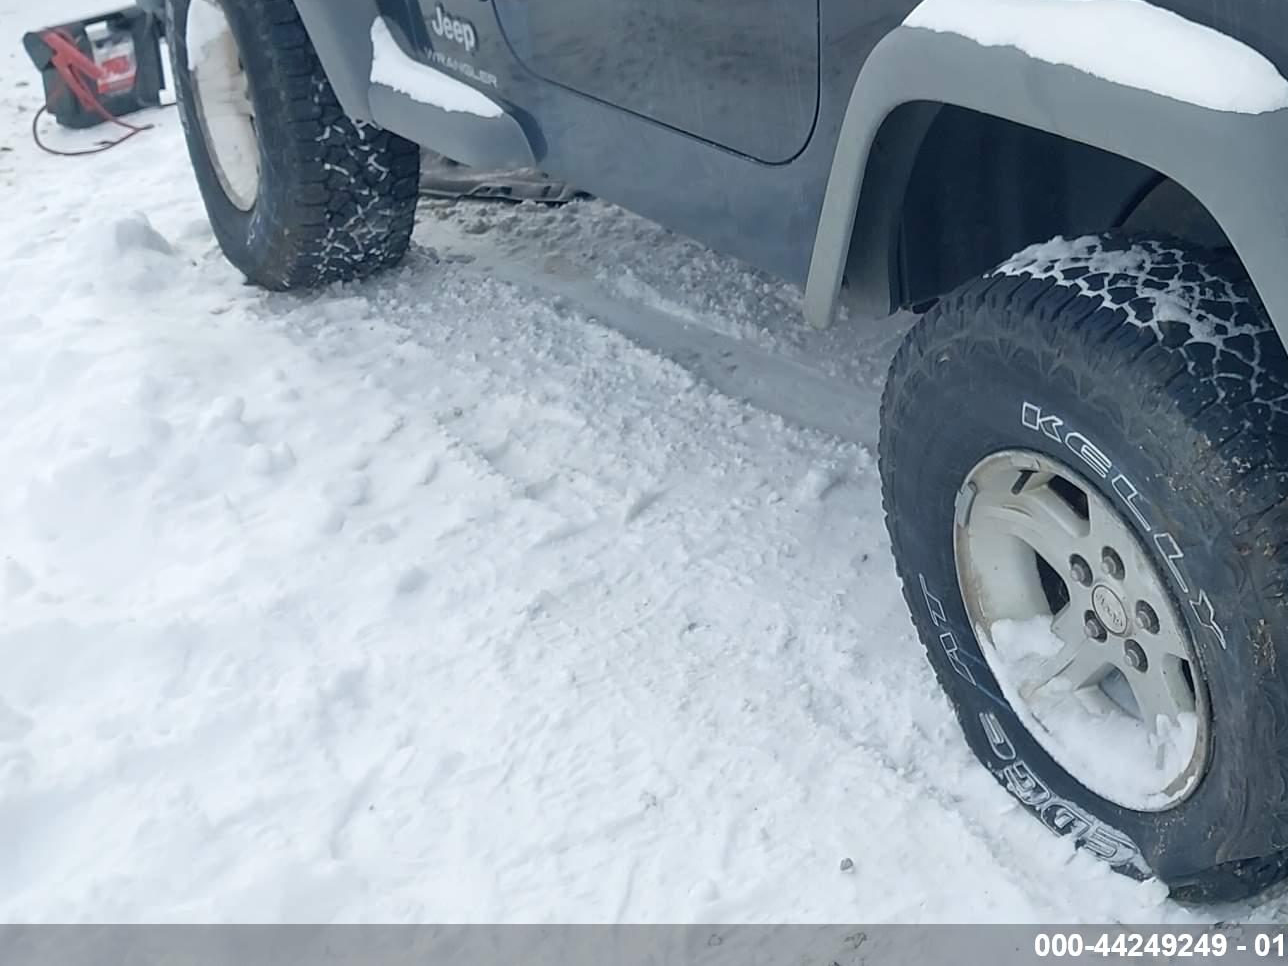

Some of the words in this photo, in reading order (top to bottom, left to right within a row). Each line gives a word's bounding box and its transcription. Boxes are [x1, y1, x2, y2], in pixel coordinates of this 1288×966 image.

[431, 5, 476, 52] Jeep
[1021, 401, 1227, 650] KELLY
[978, 712, 1142, 867] EDGE
